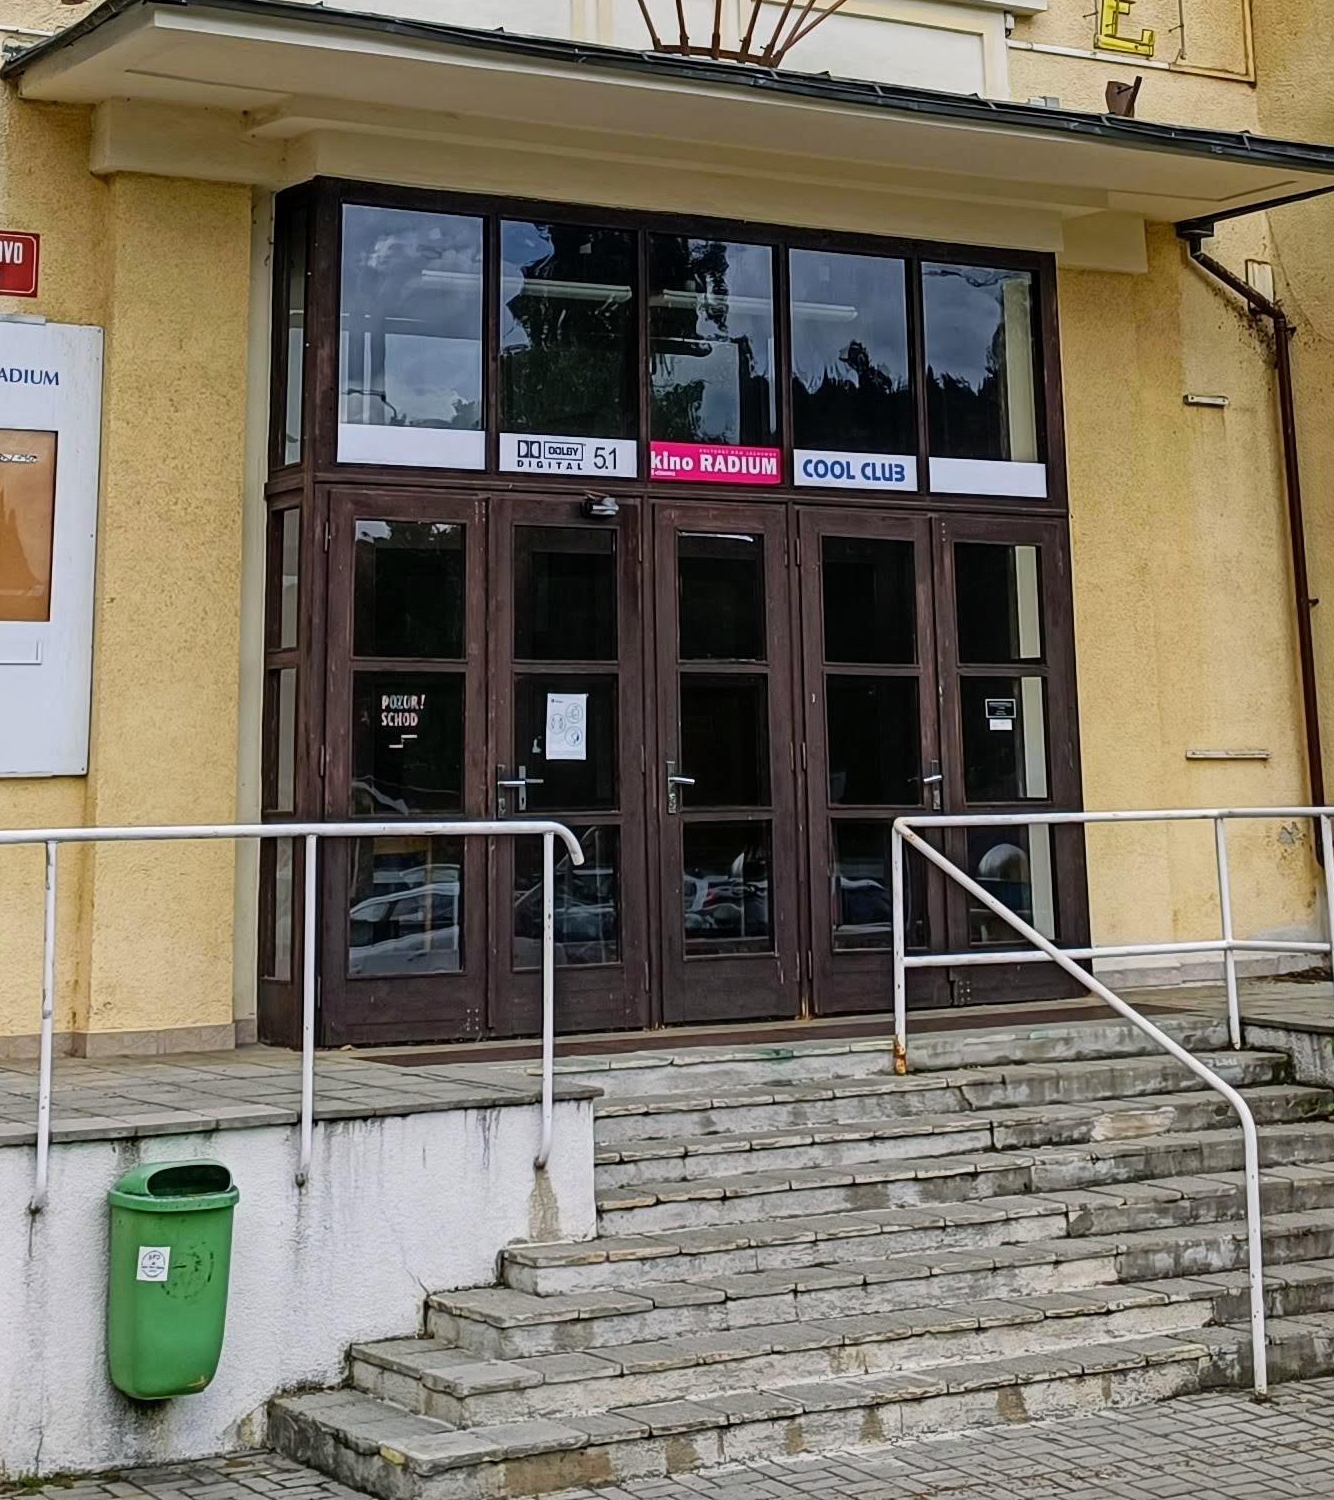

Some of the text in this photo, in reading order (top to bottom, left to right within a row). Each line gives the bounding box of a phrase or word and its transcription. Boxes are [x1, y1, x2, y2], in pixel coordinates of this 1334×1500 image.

[517, 459, 583, 470] DIGITAL
[548, 446, 617, 470] DOLBY 5.1
[650, 451, 777, 476] kino RADIUM
[802, 459, 906, 482] COOL CLUB
[381, 711, 419, 727] SCHOD
